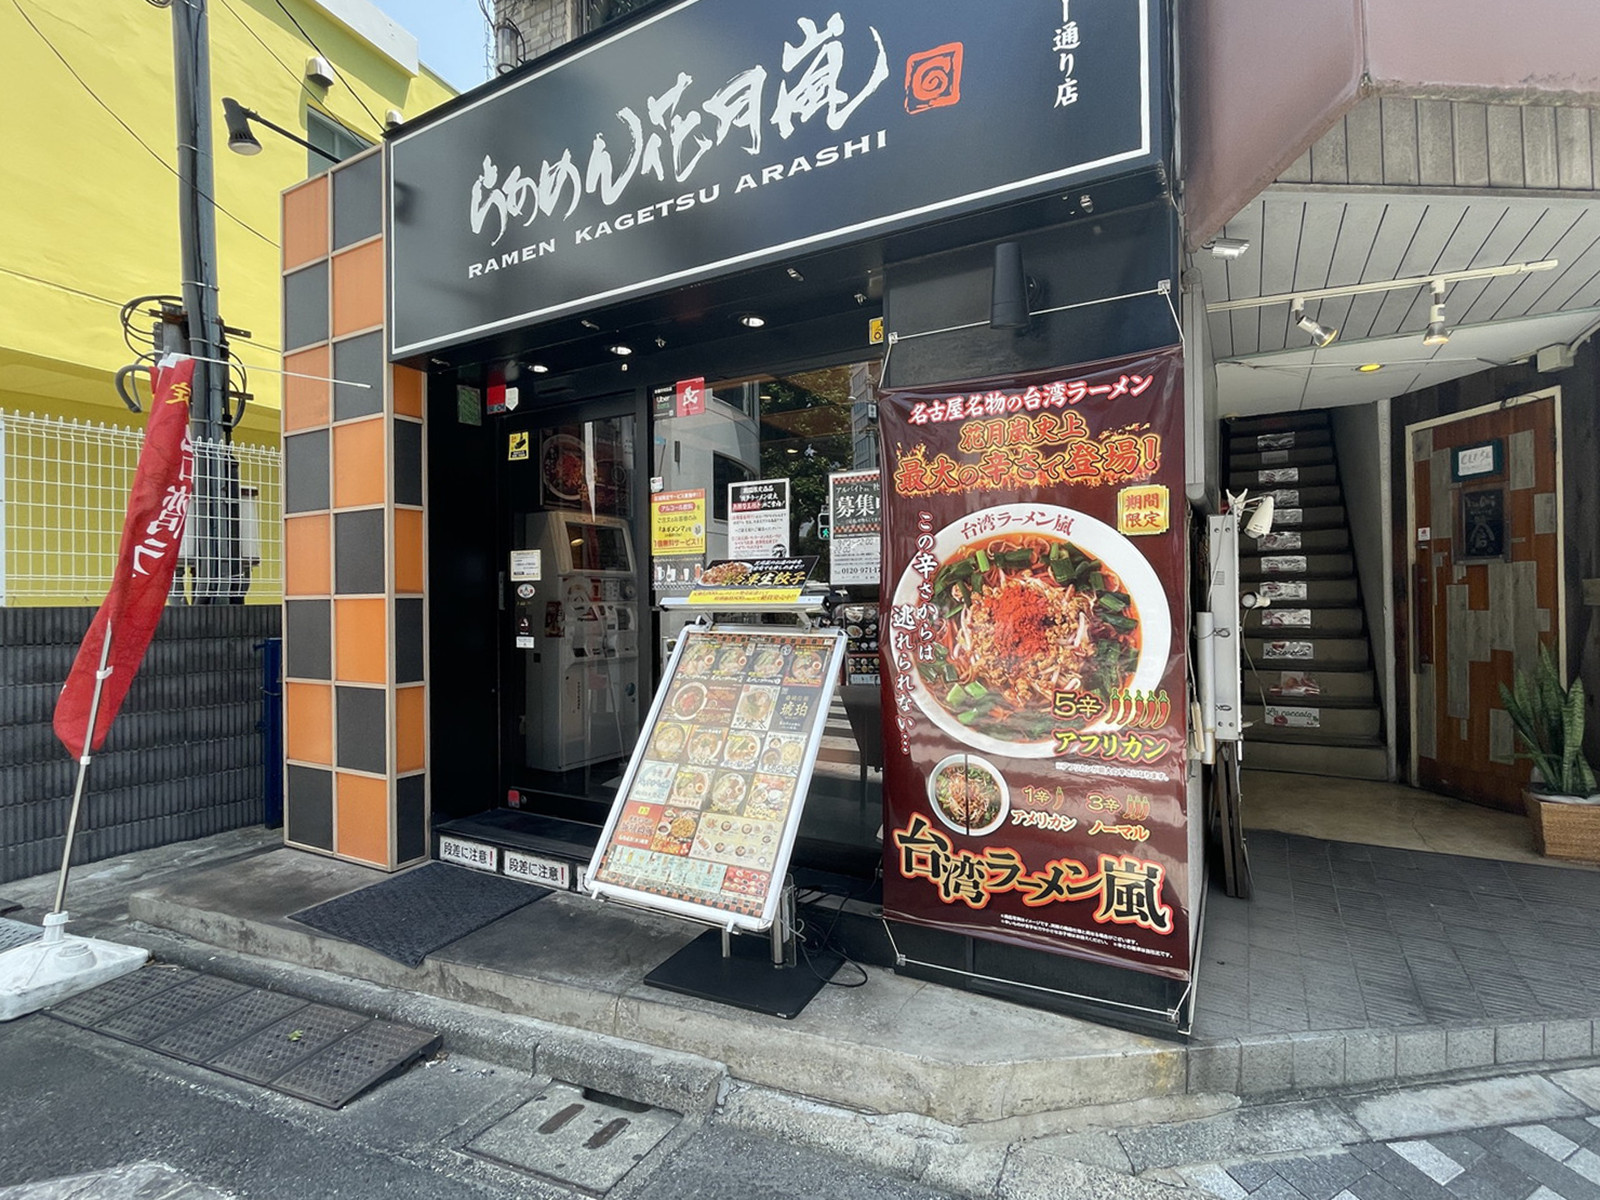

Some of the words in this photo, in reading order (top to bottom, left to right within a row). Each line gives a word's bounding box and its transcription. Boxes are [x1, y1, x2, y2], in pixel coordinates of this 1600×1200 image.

[468, 238, 556, 279] RAMEN
[575, 184, 720, 244] KAGETSU
[735, 129, 887, 193] ARASHI
[908, 375, 1153, 425] 名古屋名物の台湾ラーメン
[960, 412, 1088, 450] 花月嵐史上
[1125, 493, 1160, 509] 期間
[961, 512, 1073, 540] 台湾ラーメン嵐
[1125, 510, 1161, 528] 限定
[911, 511, 939, 663] この辛さからは
[1053, 690, 1104, 722] 5辛
[1053, 730, 1169, 761] アフリカン
[1022, 786, 1051, 805] 1辛
[1087, 794, 1121, 814] 3辛
[1011, 810, 1077, 832] アメリカン
[1088, 820, 1150, 842] ノーマル
[894, 813, 1172, 933] 台湾ラーメン嵐
